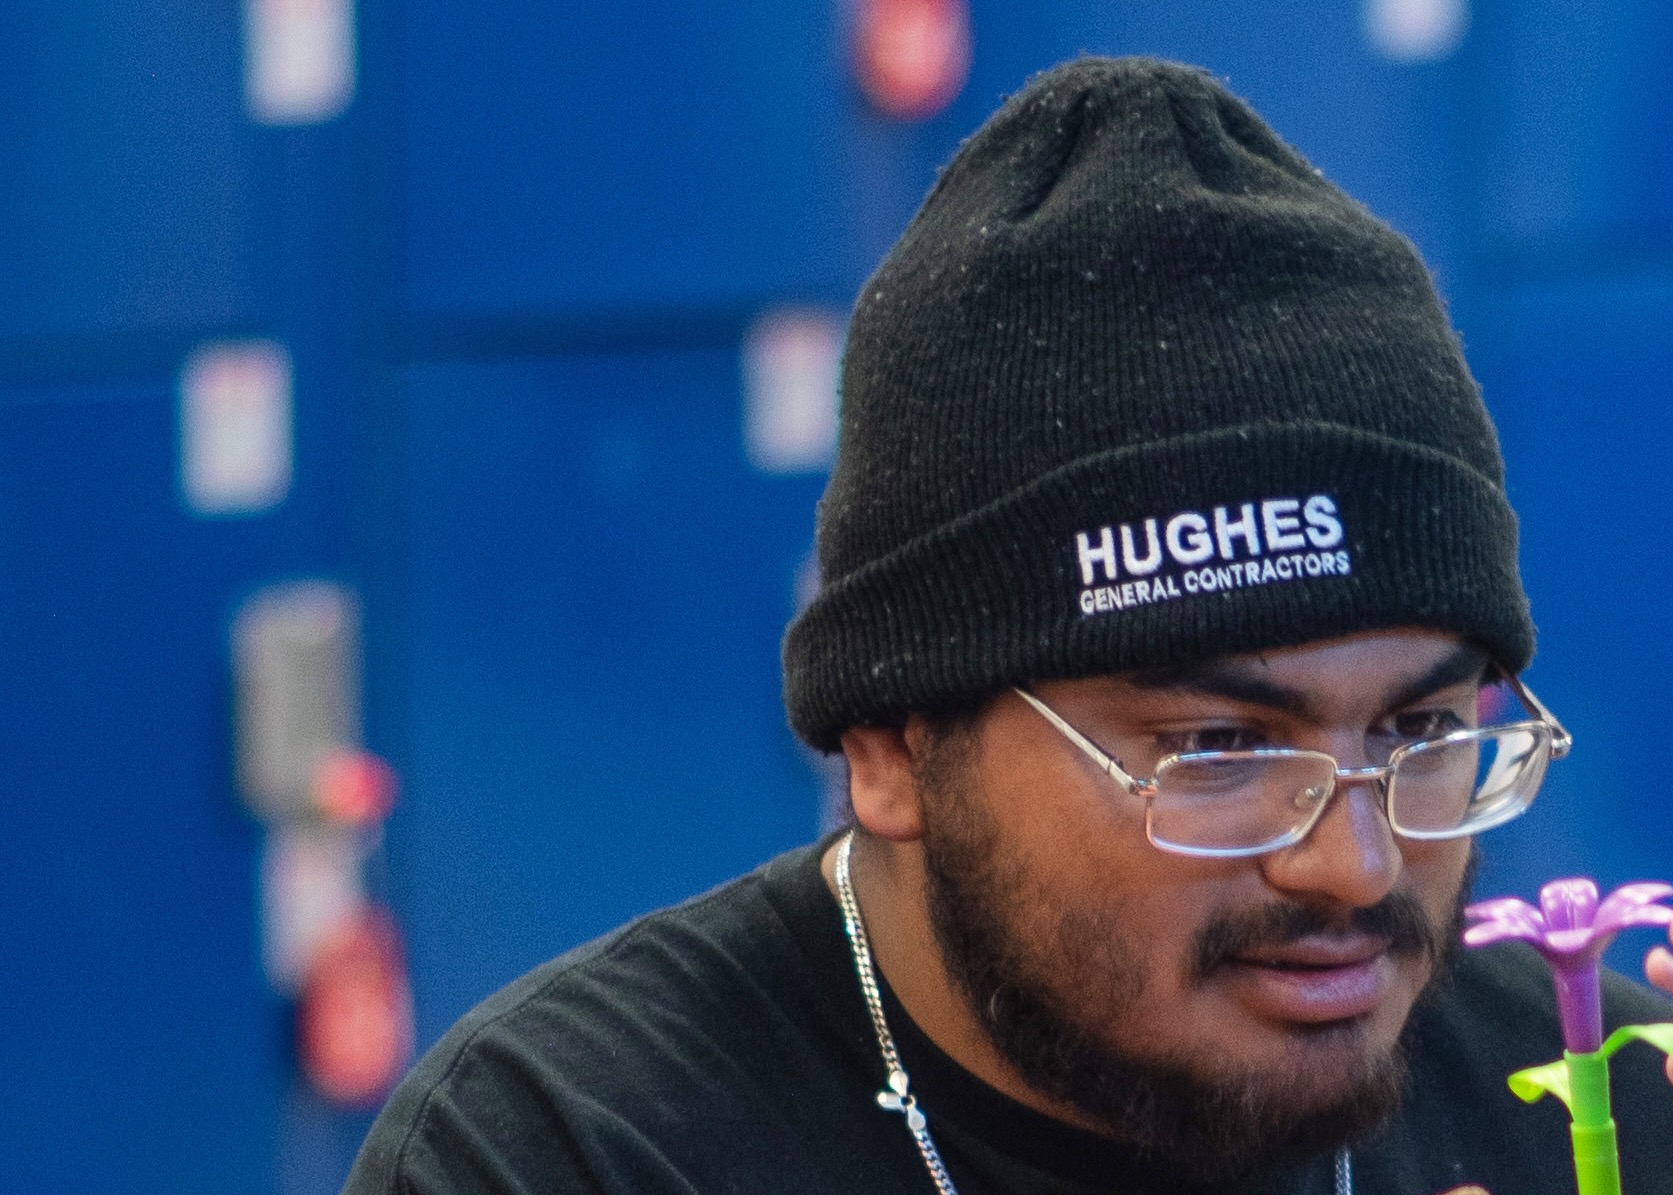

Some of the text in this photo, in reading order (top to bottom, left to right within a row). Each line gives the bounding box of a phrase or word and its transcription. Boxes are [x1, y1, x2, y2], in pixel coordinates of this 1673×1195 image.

[1075, 495, 1344, 586] HUGHES
[1079, 551, 1351, 616] GENERAL CONTRACTORS
